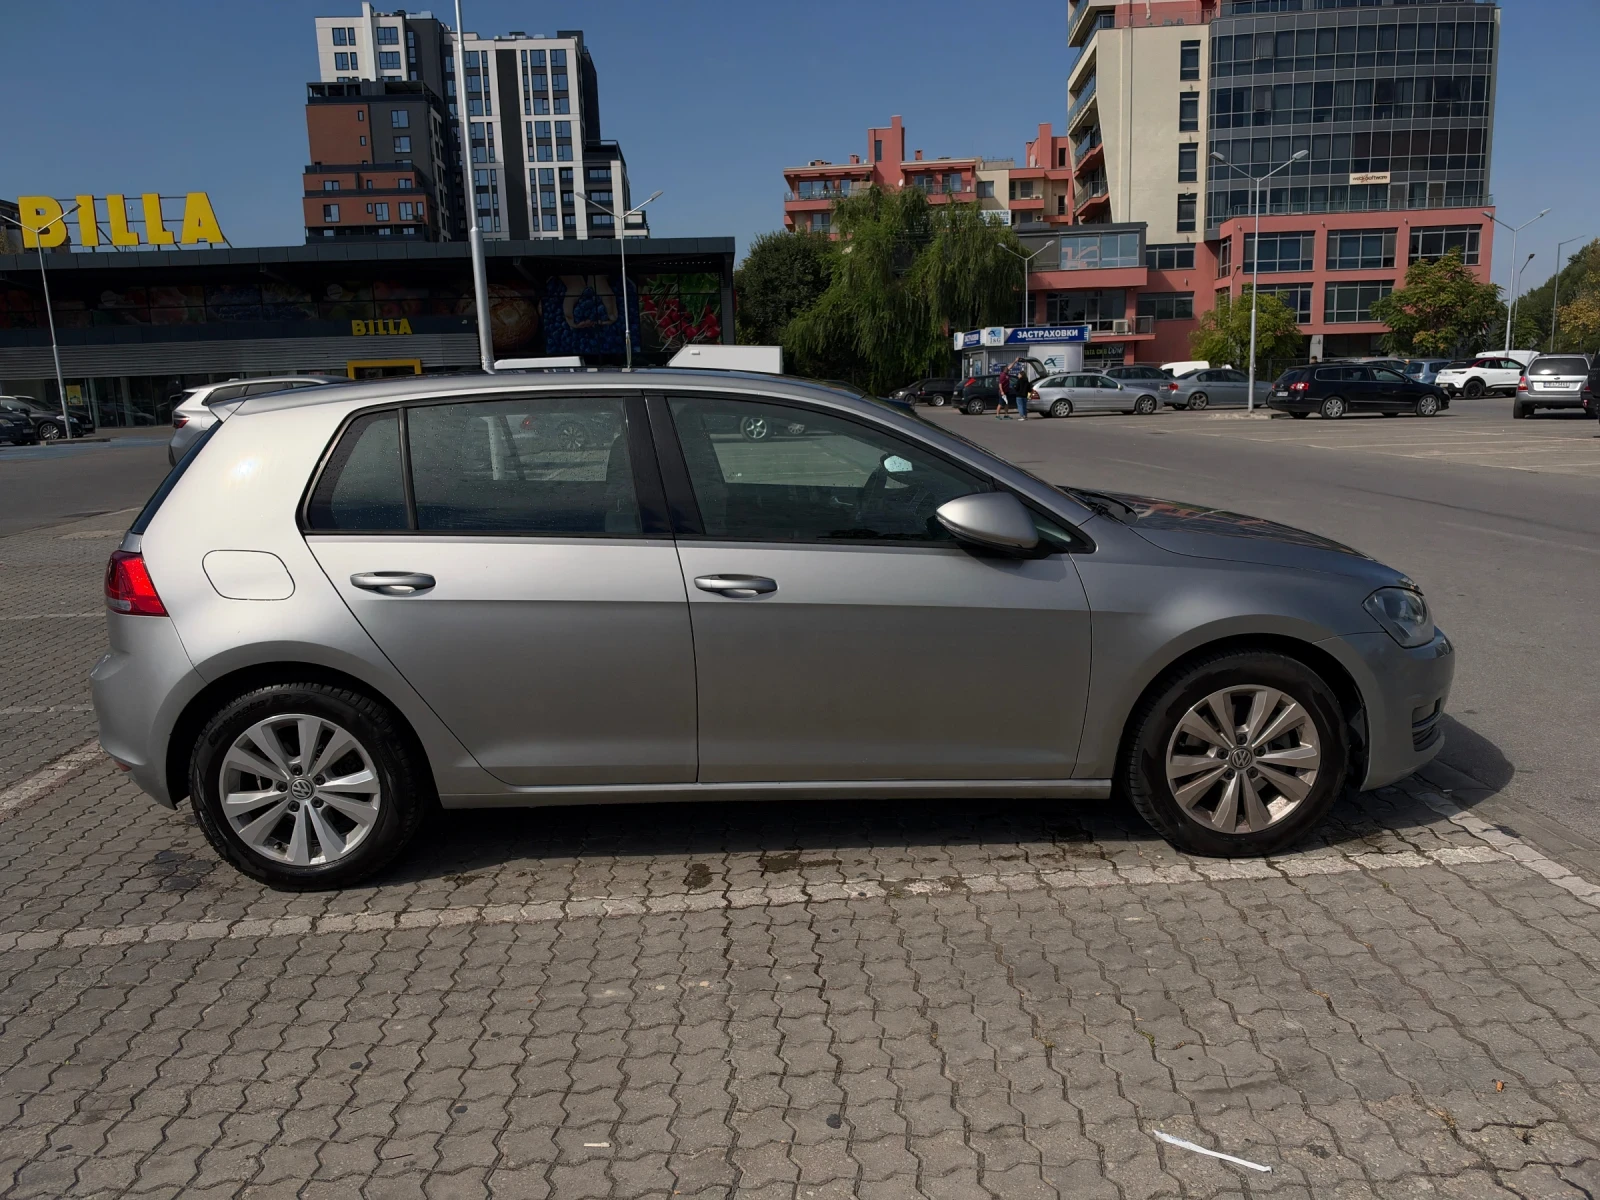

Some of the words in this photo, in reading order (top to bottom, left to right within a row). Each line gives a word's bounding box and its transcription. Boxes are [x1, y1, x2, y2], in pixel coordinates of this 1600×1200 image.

[18, 192, 225, 248] BILLA
[351, 318, 413, 336] BILLA
[1016, 329, 1079, 339] ЗАСТРАХОВКИ
